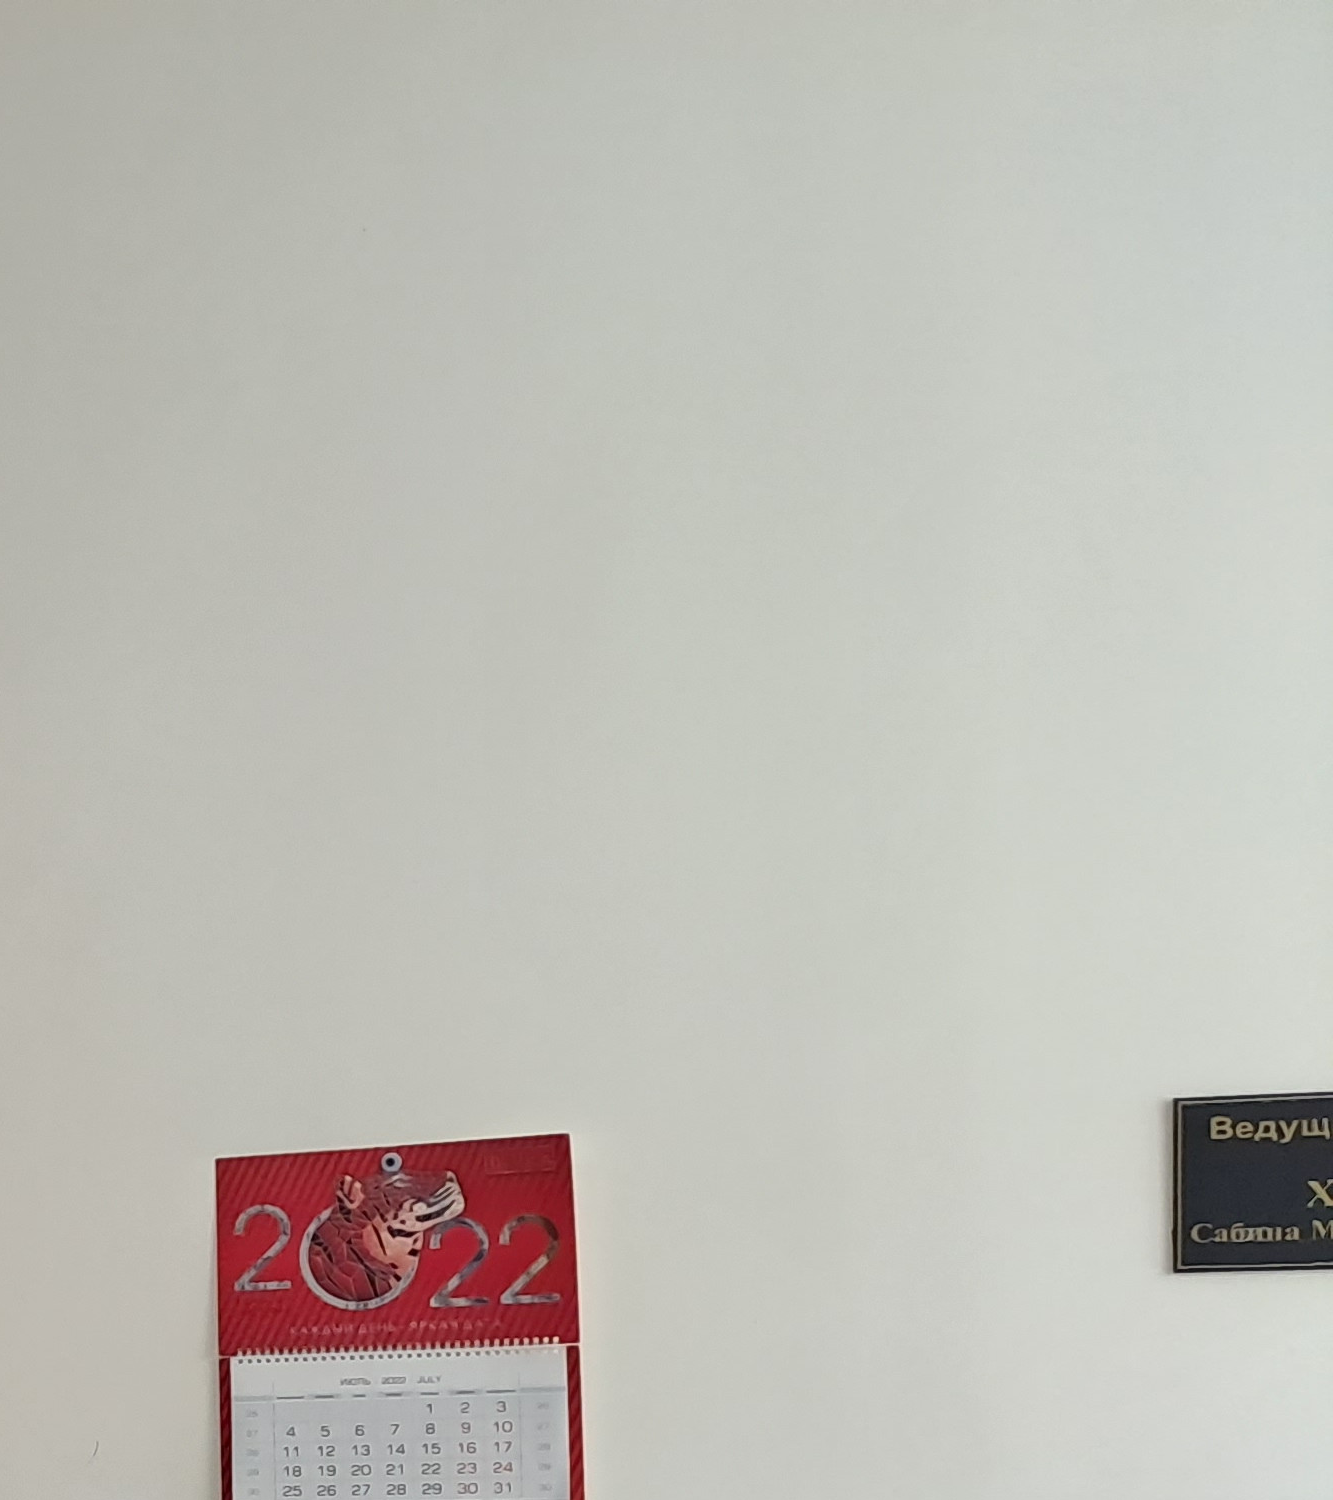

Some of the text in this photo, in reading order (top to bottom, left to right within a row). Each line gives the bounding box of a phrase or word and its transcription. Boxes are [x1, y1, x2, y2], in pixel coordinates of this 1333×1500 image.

[1209, 1115, 1331, 1143] Ведущ
[233, 1204, 561, 1311] 2022
[426, 1400, 507, 1414] 1 2 3
[285, 1420, 514, 1438] 4 5 6 7 8 9 10
[283, 1440, 513, 1458] 11 12 13 14 15 16 17
[282, 1465, 303, 1478] 18
[317, 1464, 337, 1477] 19
[350, 1463, 372, 1477] 20
[385, 1463, 404, 1476] 21
[420, 1462, 442, 1476] 22
[456, 1462, 478, 1475] 23
[492, 1461, 514, 1474] 24
[282, 1484, 303, 1498] 25
[316, 1484, 337, 1497] 26
[350, 1483, 371, 1497] 27
[386, 1483, 407, 1496] 28
[421, 1482, 443, 1496] 29
[456, 1482, 479, 1495] 30
[493, 1481, 512, 1495] 31
